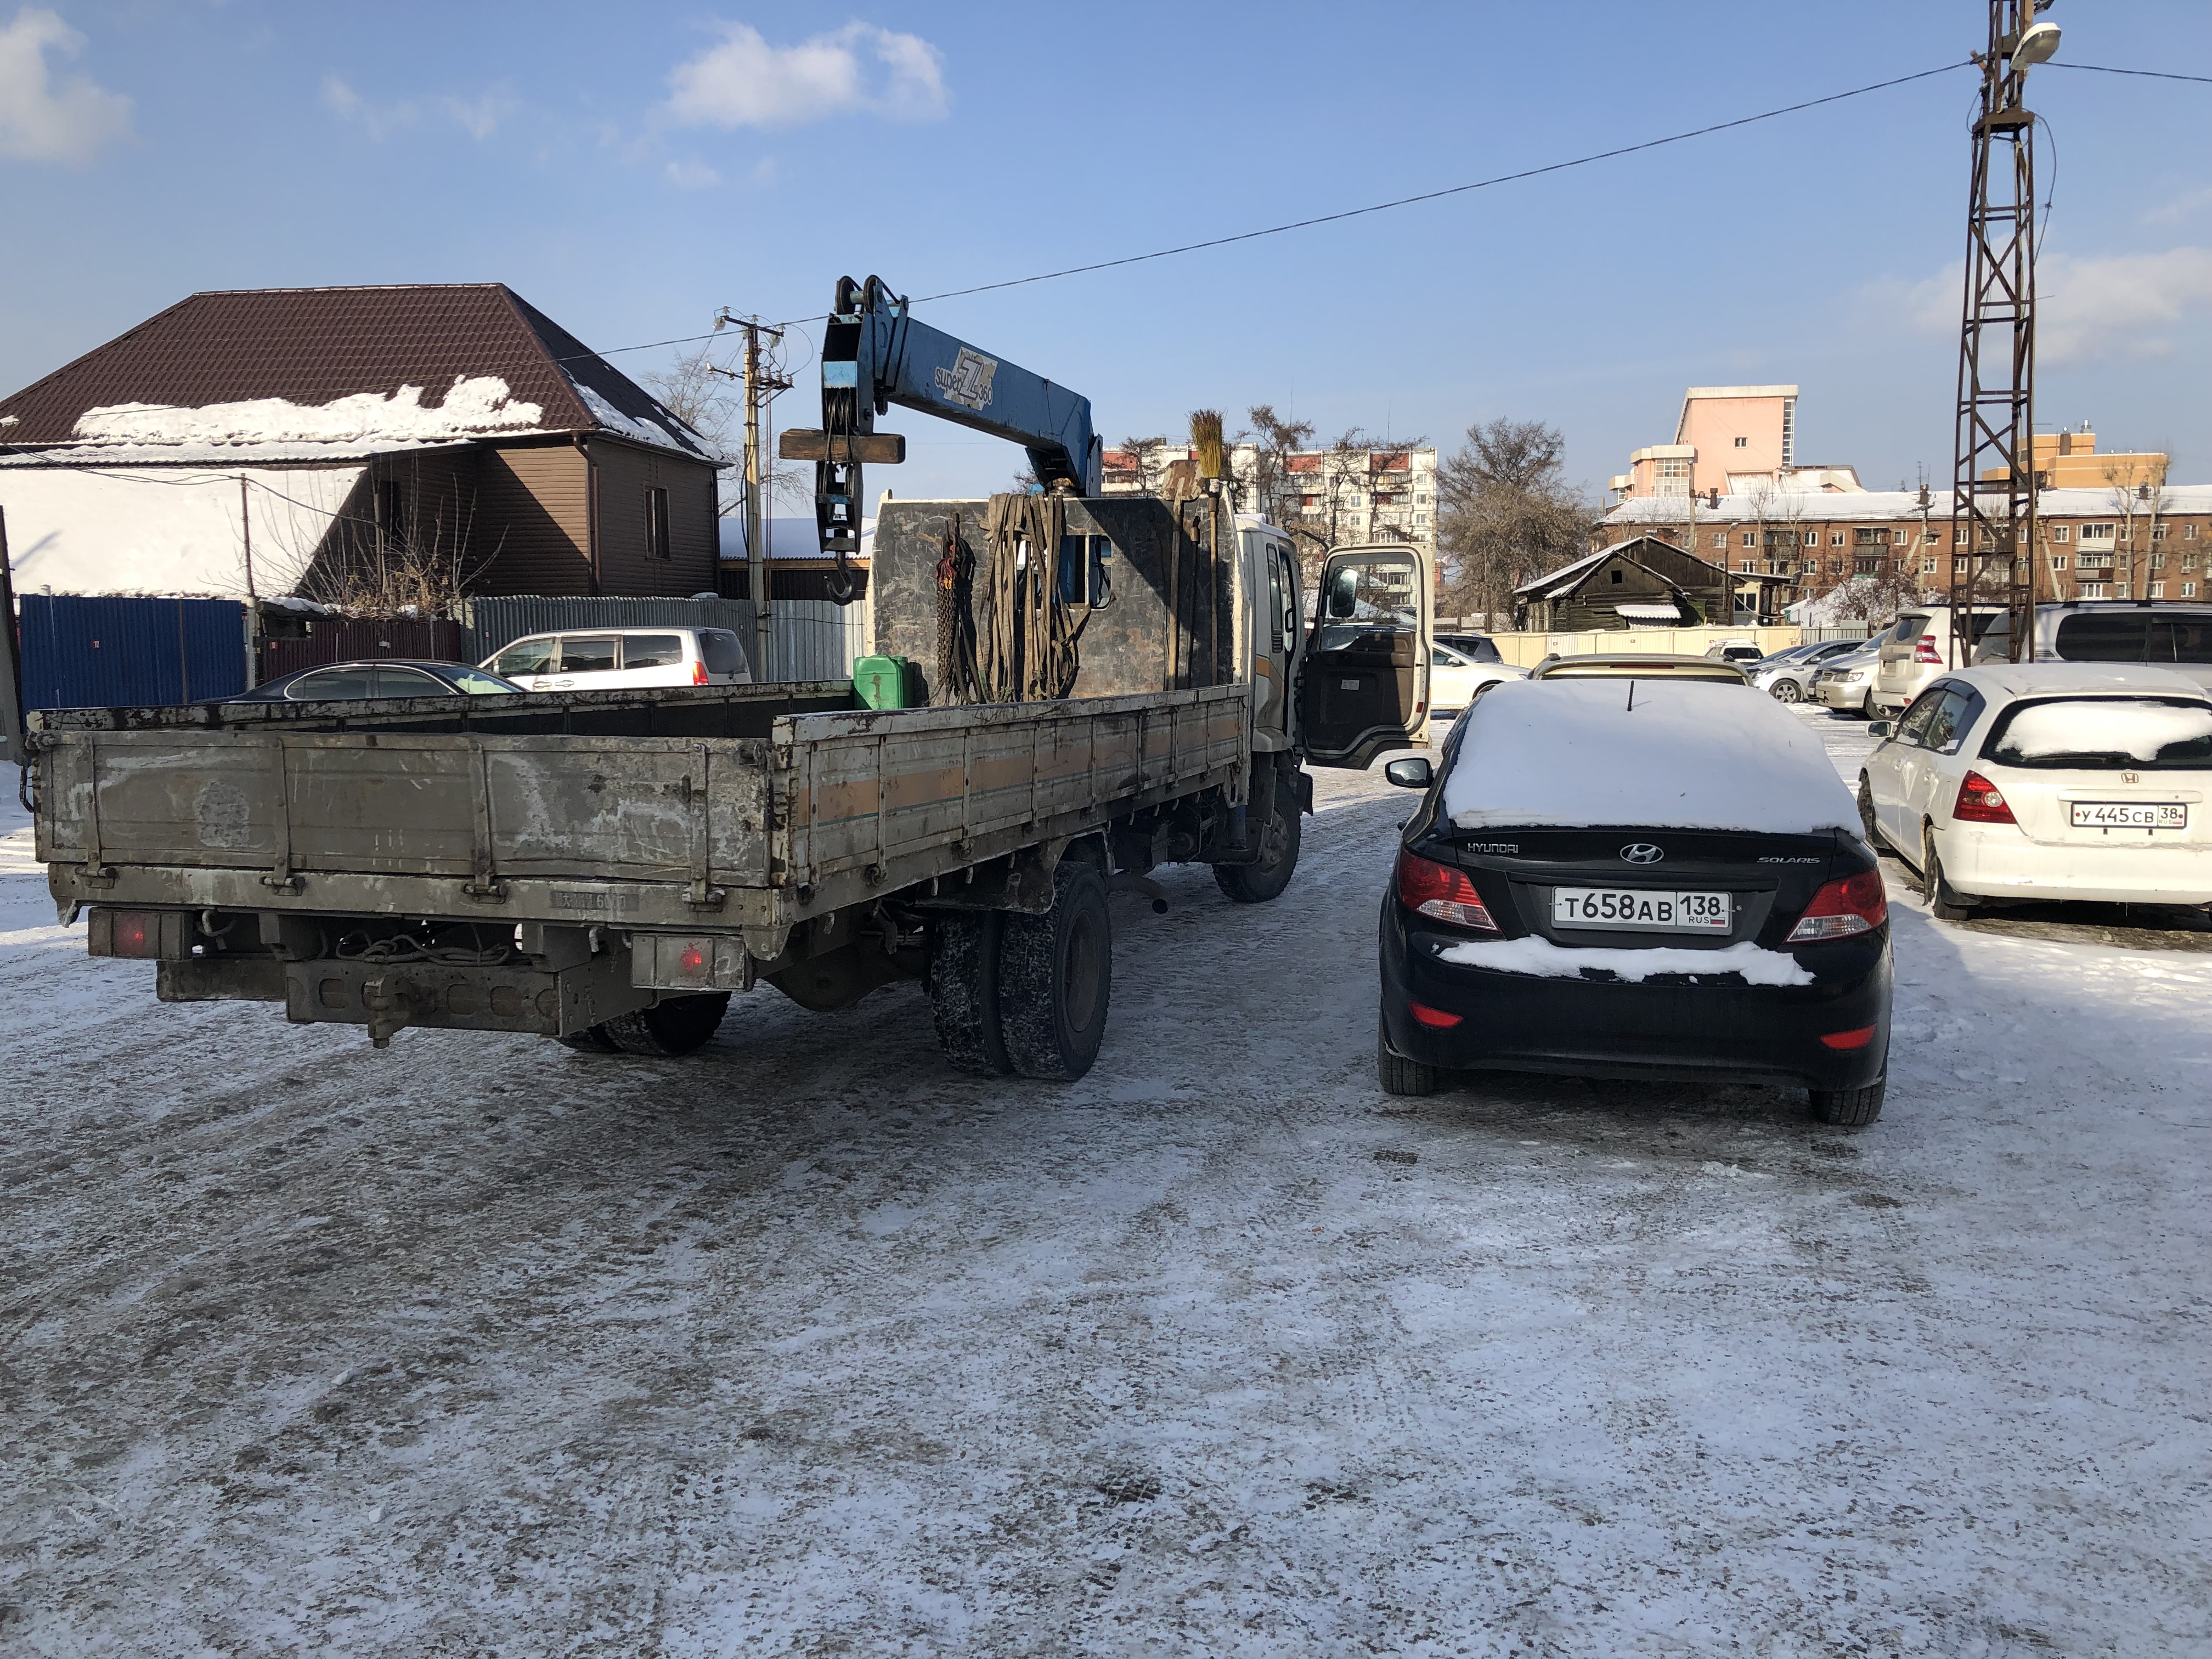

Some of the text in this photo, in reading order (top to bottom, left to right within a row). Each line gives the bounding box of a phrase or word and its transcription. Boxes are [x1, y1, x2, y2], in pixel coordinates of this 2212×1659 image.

[935, 368, 962, 393] super
[979, 383, 992, 404] 360
[2160, 808, 2178, 819] 38
[1468, 843, 1519, 854] HYUNDAI
[1565, 893, 1721, 922] Т658АВ 138
